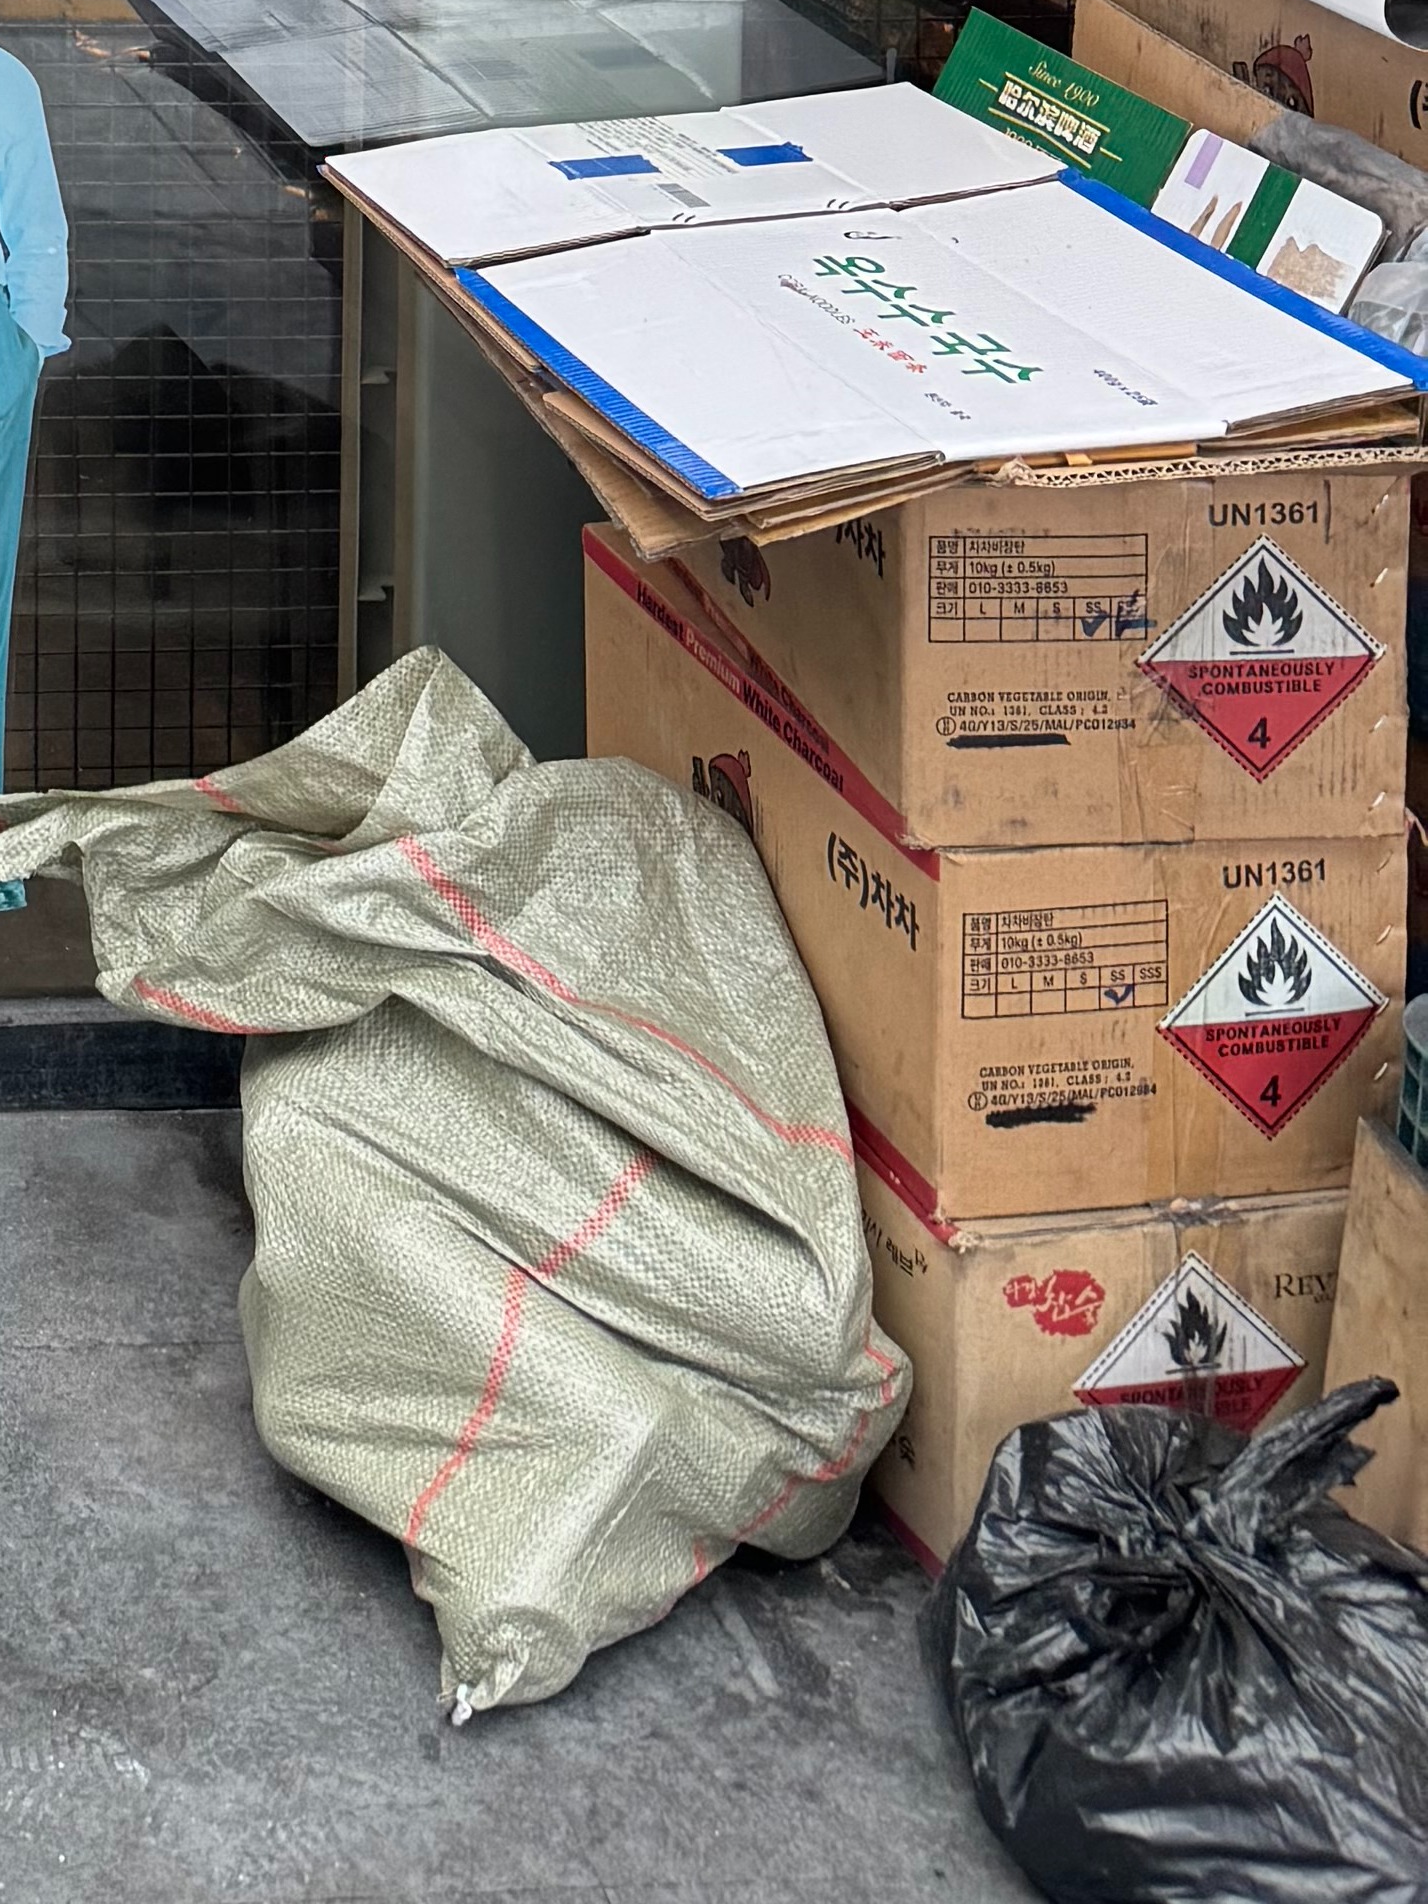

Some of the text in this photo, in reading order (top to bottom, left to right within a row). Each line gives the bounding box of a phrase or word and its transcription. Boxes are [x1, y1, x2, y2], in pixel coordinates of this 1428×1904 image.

[1028, 60, 1101, 108] Since 1900
[1207, 500, 1321, 528] UN1361
[969, 561, 998, 577] 10kg
[936, 601, 958, 616] 크기
[980, 602, 987, 615] L
[1014, 602, 1025, 614] M
[1053, 601, 1061, 614] S
[1085, 601, 1102, 614] SS
[1188, 661, 1335, 679] SPONTANEOUSLY
[636, 580, 845, 793] Hardest Premium White Charcoal
[947, 691, 995, 704] CARBON
[998, 690, 1063, 703] VEGETABLE
[1201, 679, 1322, 695] COMBUSTIBLE
[949, 706, 966, 717] UN
[1247, 716, 1271, 749] 4
[1222, 859, 1327, 890] UN1361
[826, 830, 920, 952] (주)차차
[1001, 936, 1029, 952] 10kg
[969, 966, 1162, 992] 크기 L M S SS SSS
[1205, 1017, 1342, 1042] SPONTANEOUSLY
[1217, 1035, 1329, 1058] COMBUSTIBLE
[979, 1064, 1025, 1079] CARBON
[1028, 1060, 1089, 1076] VEGETABLE
[981, 1080, 999, 1092] UN
[1259, 1074, 1282, 1107] 4
